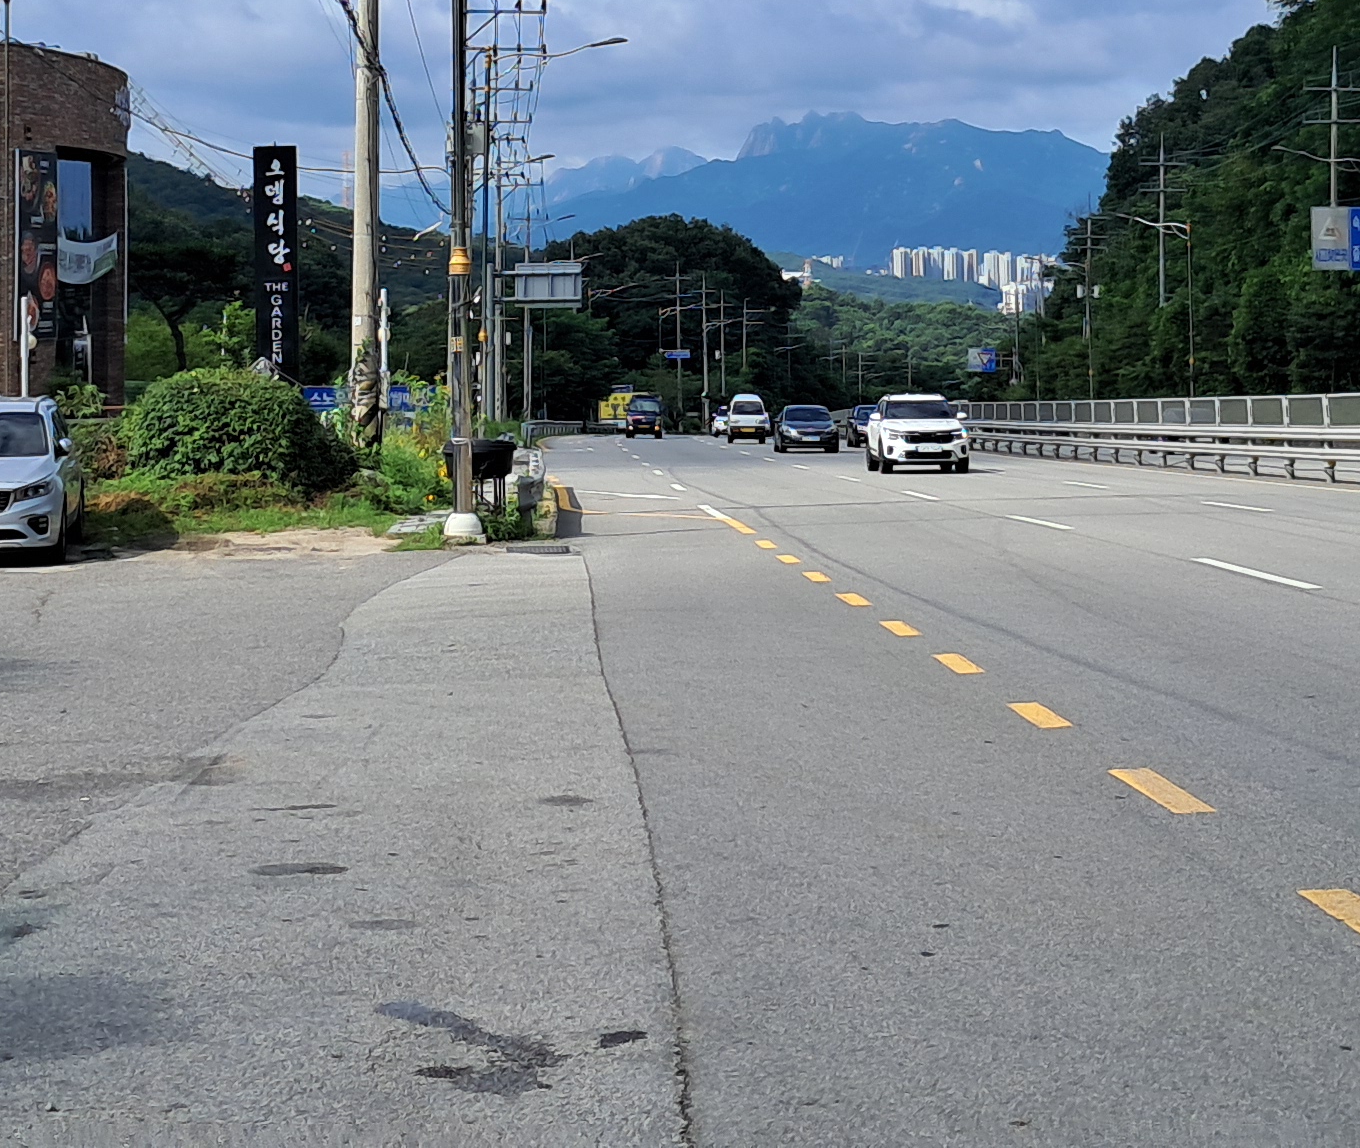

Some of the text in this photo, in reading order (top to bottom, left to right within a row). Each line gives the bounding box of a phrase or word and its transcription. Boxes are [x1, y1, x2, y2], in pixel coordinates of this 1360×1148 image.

[264, 158, 291, 265] 오뎅식당
[264, 281, 289, 292] THE
[270, 294, 283, 364] GARDEN
